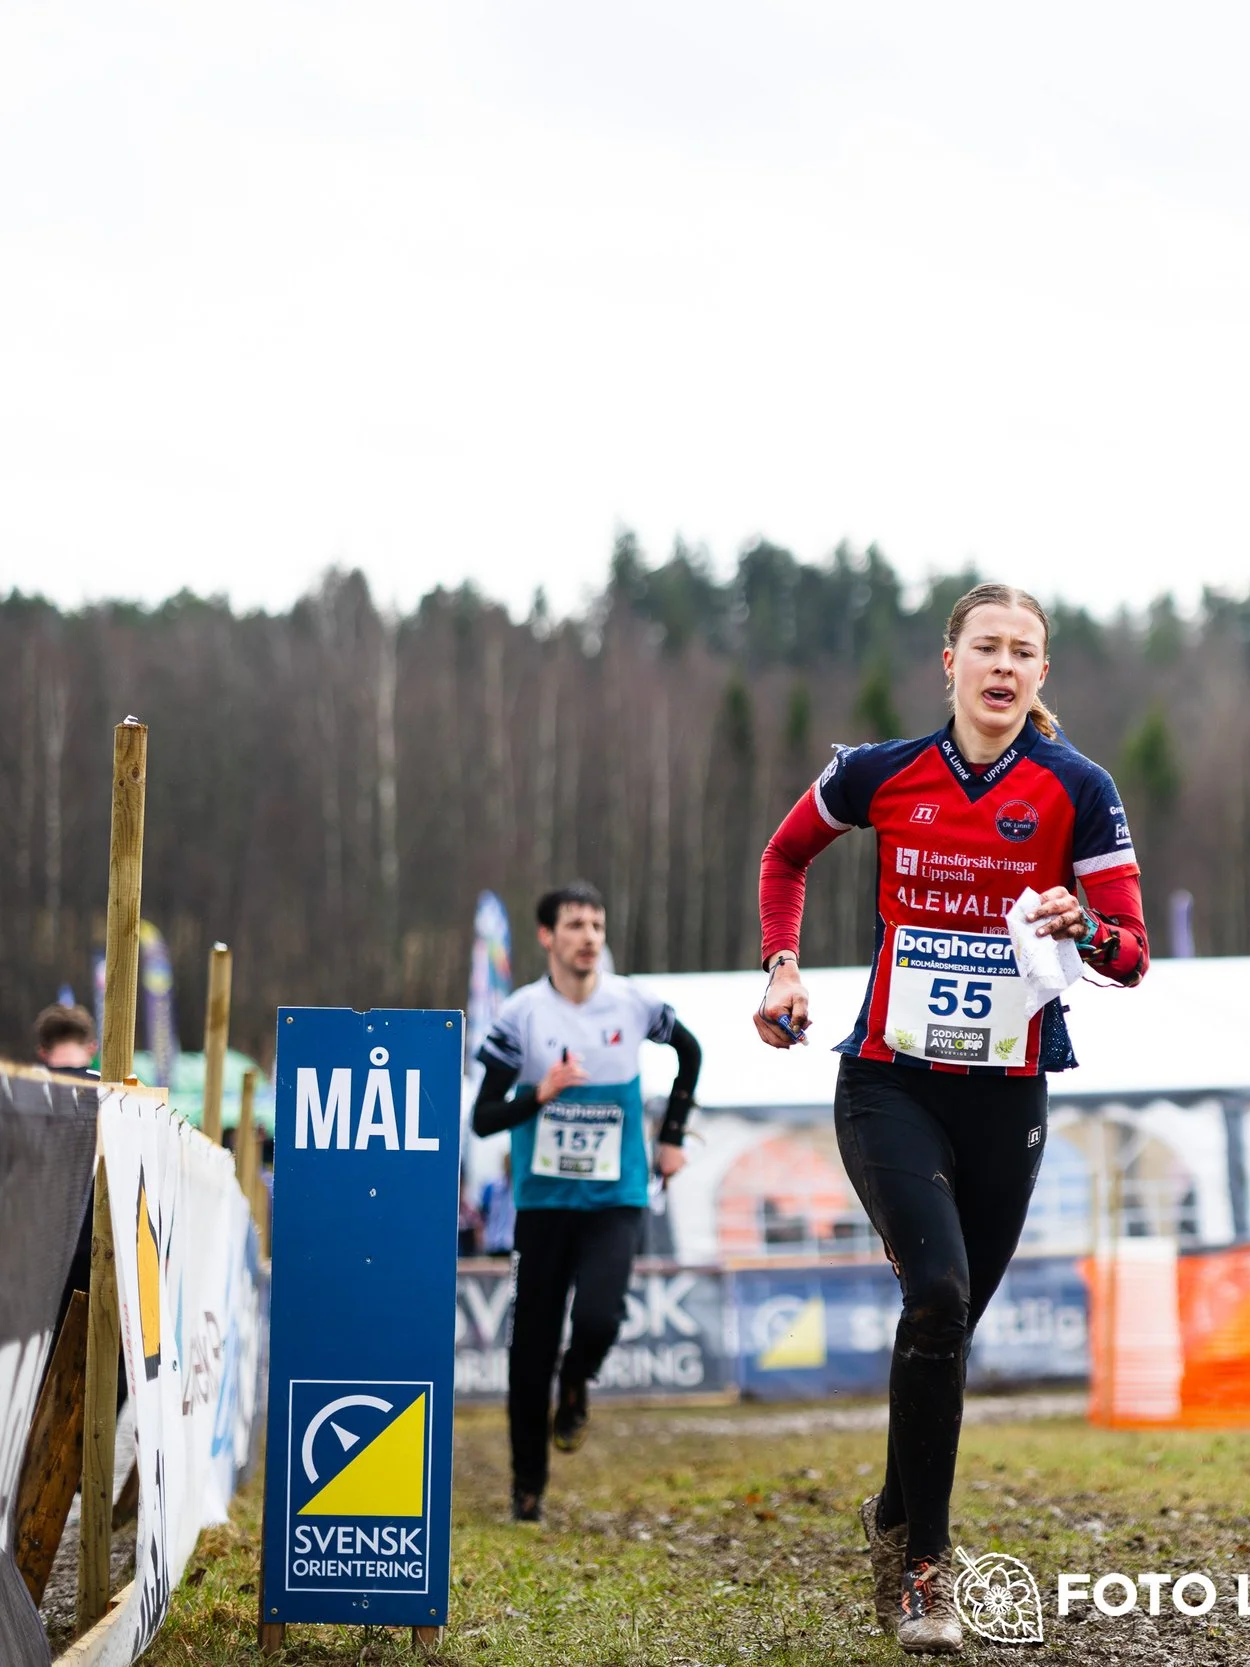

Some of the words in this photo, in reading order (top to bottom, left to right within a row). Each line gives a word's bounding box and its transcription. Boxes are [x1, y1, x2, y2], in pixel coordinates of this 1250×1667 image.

[942, 740, 955, 756] OK
[949, 755, 971, 780] Linné
[983, 749, 1018, 782] UPPSALA
[922, 851, 1037, 874] Länsförsäkringar
[922, 866, 975, 882] Uppsala
[898, 931, 1014, 960] bagheer
[910, 960, 976, 973] KOLMÅRDSMEDELN
[928, 978, 992, 1019] 55
[932, 1029, 984, 1040] GODKÄNDA
[295, 1046, 440, 1152] MÅL
[553, 1129, 607, 1151] 157
[294, 1524, 422, 1556] SVENSK
[292, 1559, 423, 1579] ORIENTERING
